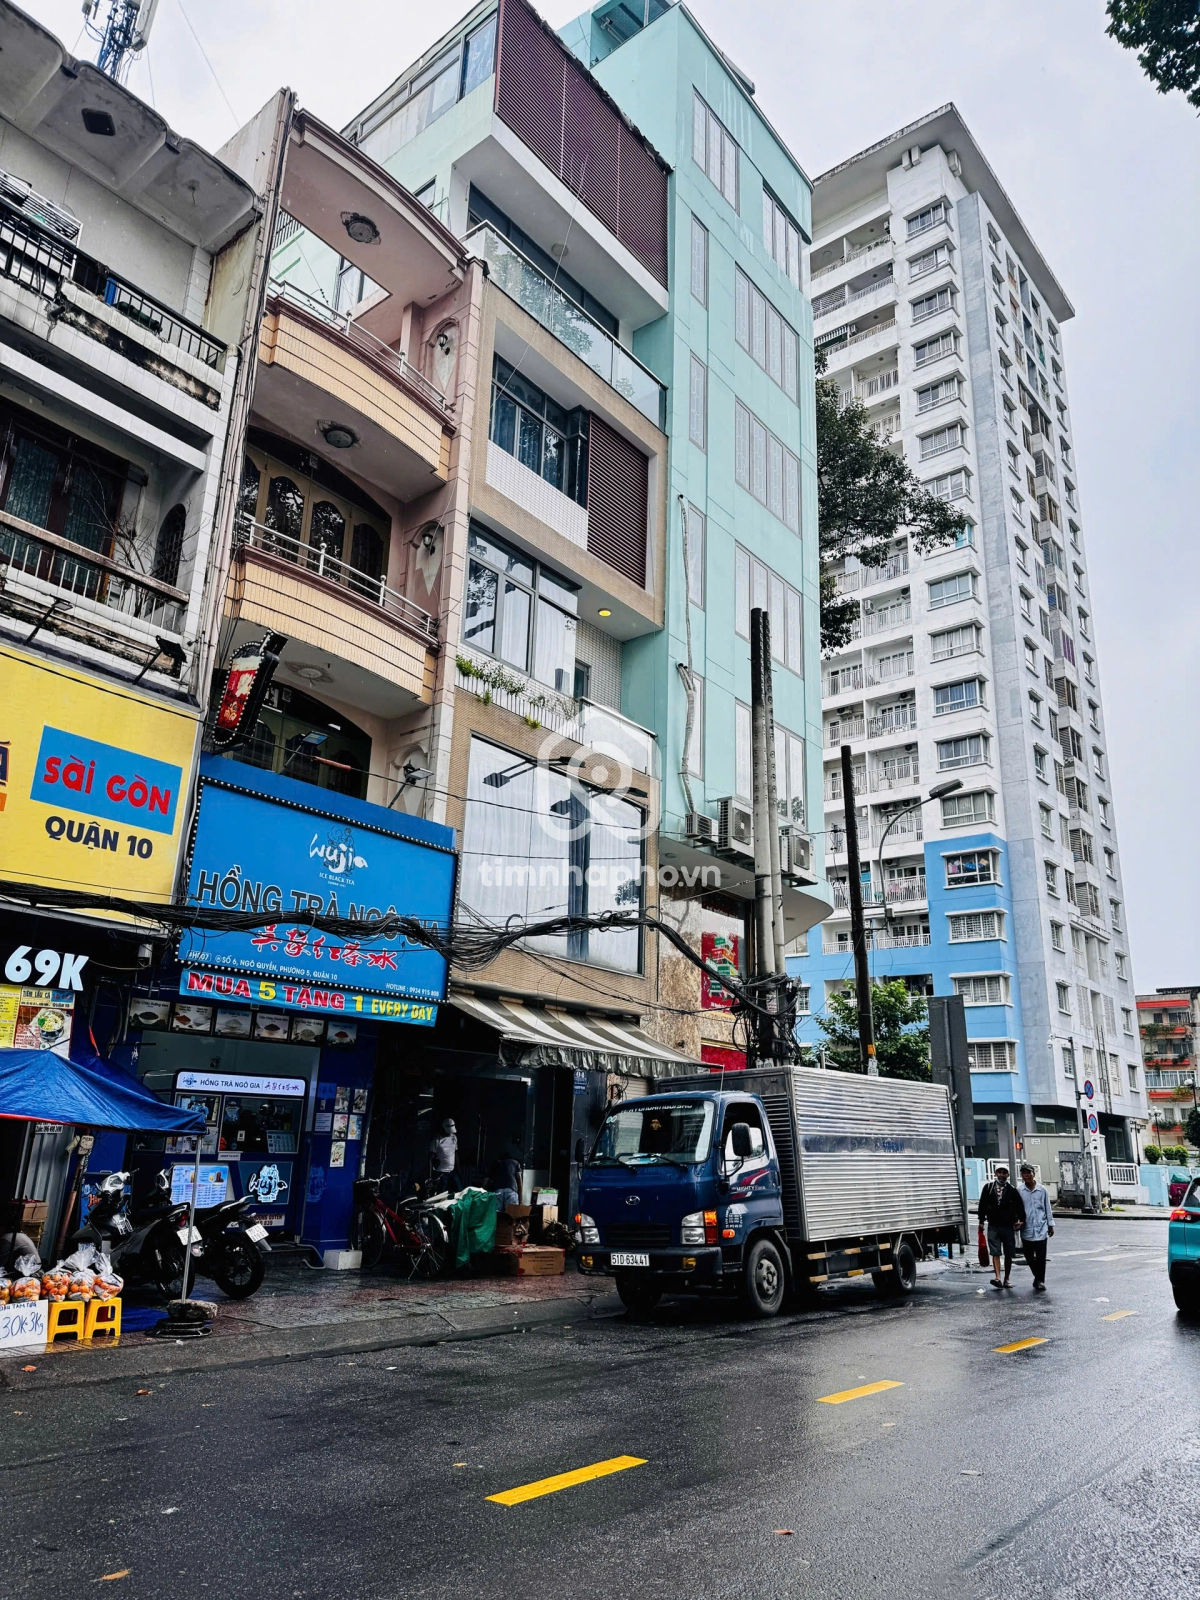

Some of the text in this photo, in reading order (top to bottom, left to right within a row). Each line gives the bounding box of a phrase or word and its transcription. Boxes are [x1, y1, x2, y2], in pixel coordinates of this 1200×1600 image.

[106, 774, 171, 815] GÒN
[45, 816, 153, 859] QUẬN 10
[197, 864, 282, 914] HỒNG
[346, 878, 355, 886] TEA
[4, 945, 90, 991] 69K
[222, 950, 232, 964] SỐ
[240, 959, 255, 969] NGÔ
[331, 973, 338, 981] 10
[187, 971, 434, 1021] MUA 5 TẶNG 1 EVERY DAY
[386, 982, 406, 992] HOTLINE
